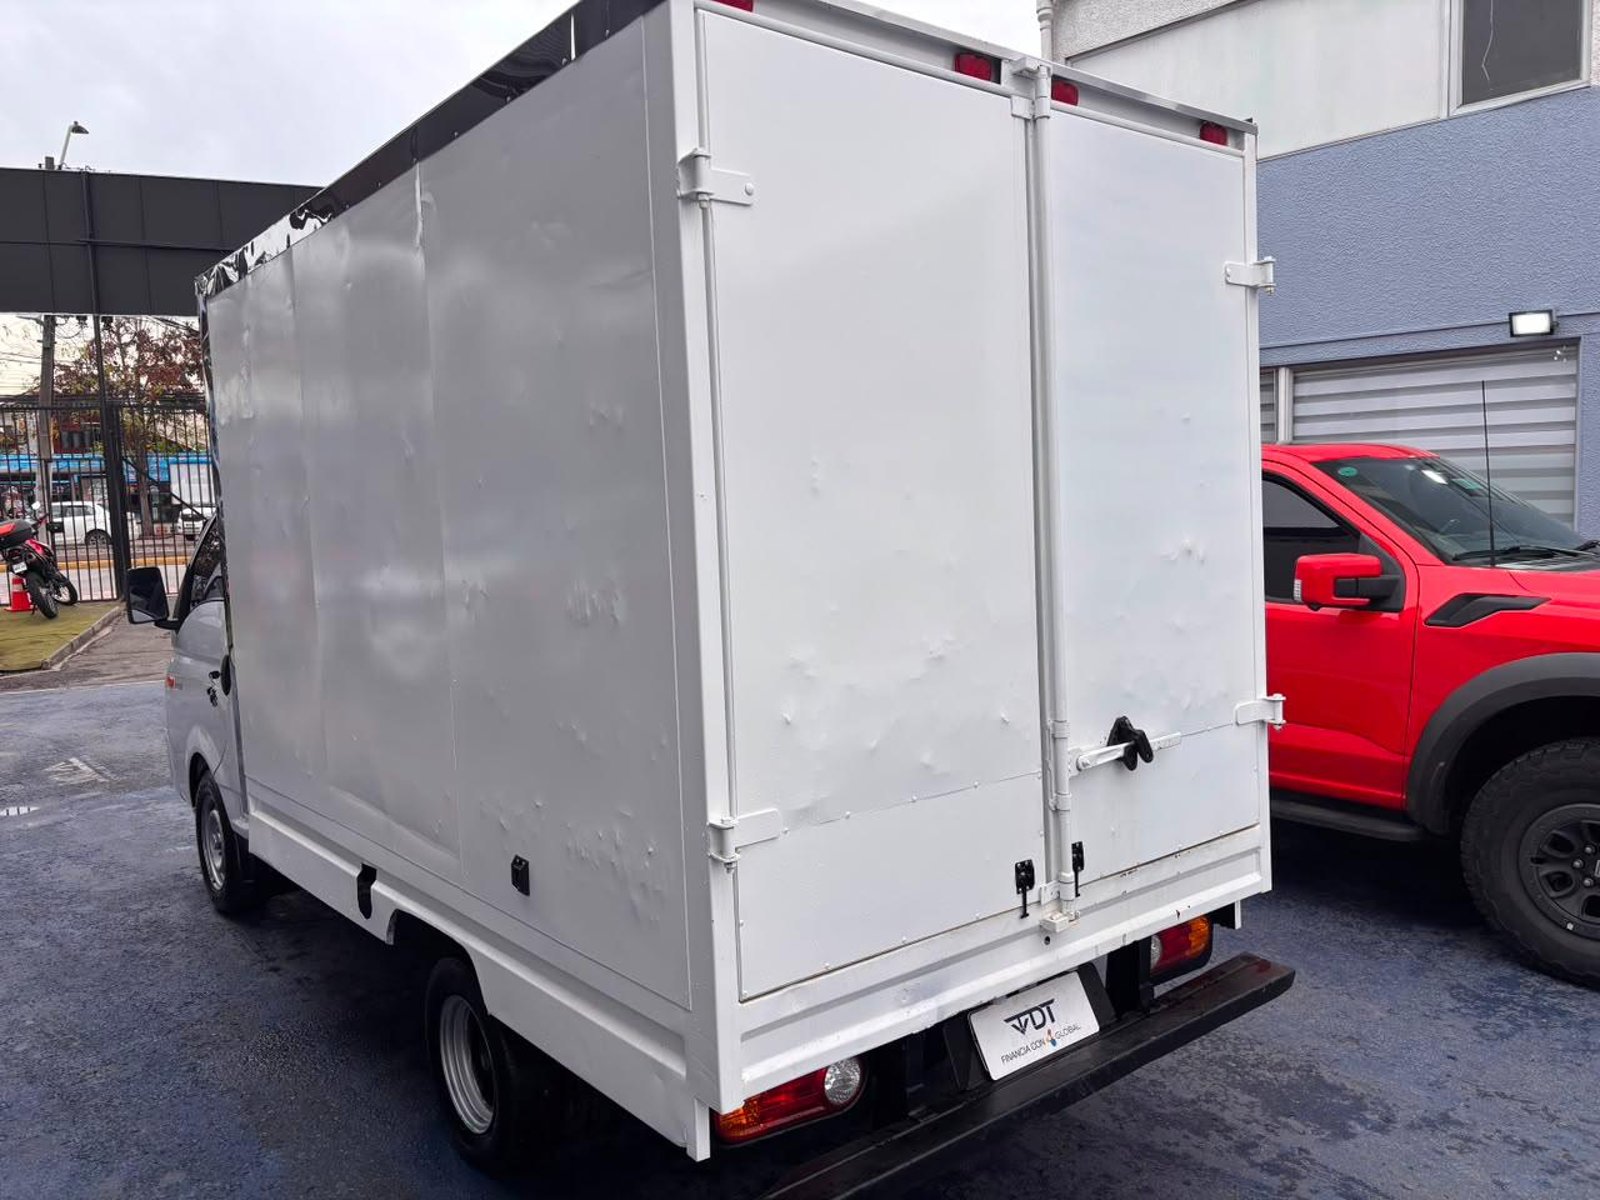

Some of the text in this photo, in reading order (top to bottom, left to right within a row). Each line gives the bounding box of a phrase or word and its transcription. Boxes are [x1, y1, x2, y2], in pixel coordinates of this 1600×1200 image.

[1004, 998, 1055, 1035] VDT
[1001, 1024, 1081, 1064] FINANCIA CON GLOBAL
